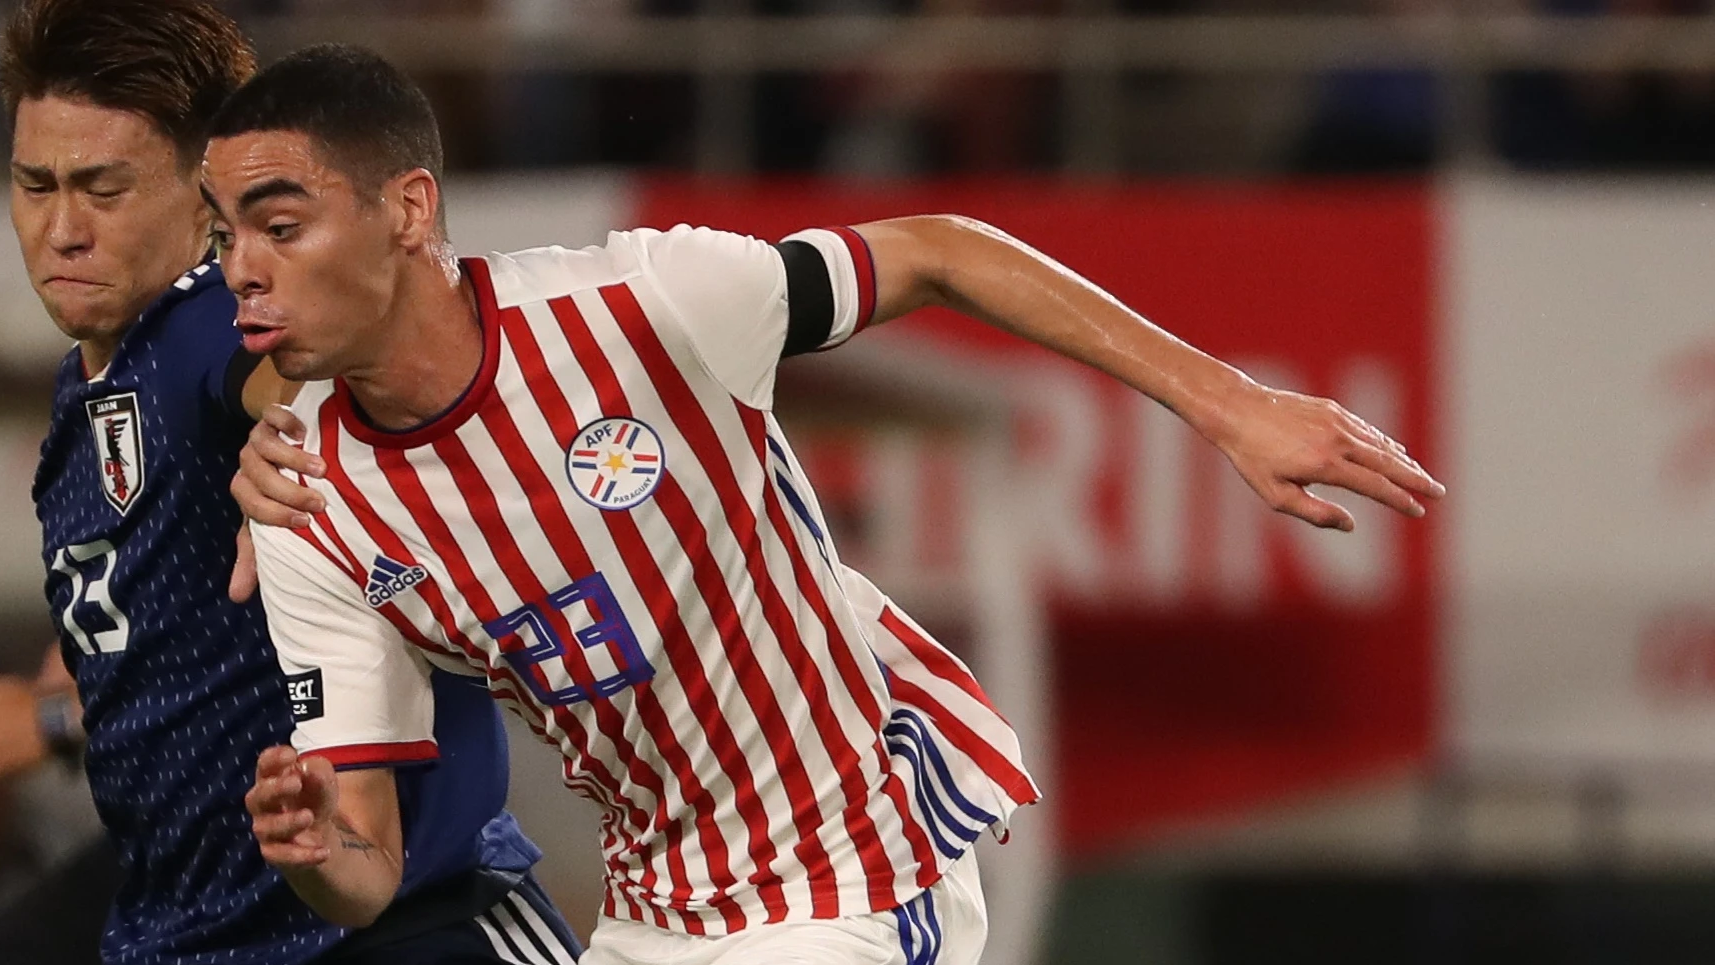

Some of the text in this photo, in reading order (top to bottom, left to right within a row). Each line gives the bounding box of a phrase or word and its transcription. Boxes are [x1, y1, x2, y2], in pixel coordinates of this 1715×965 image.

[585, 423, 613, 448] APF
[613, 476, 652, 504] PARAGUAY
[51, 538, 129, 655] 13
[368, 566, 425, 606] adidas
[481, 570, 657, 706] 23
